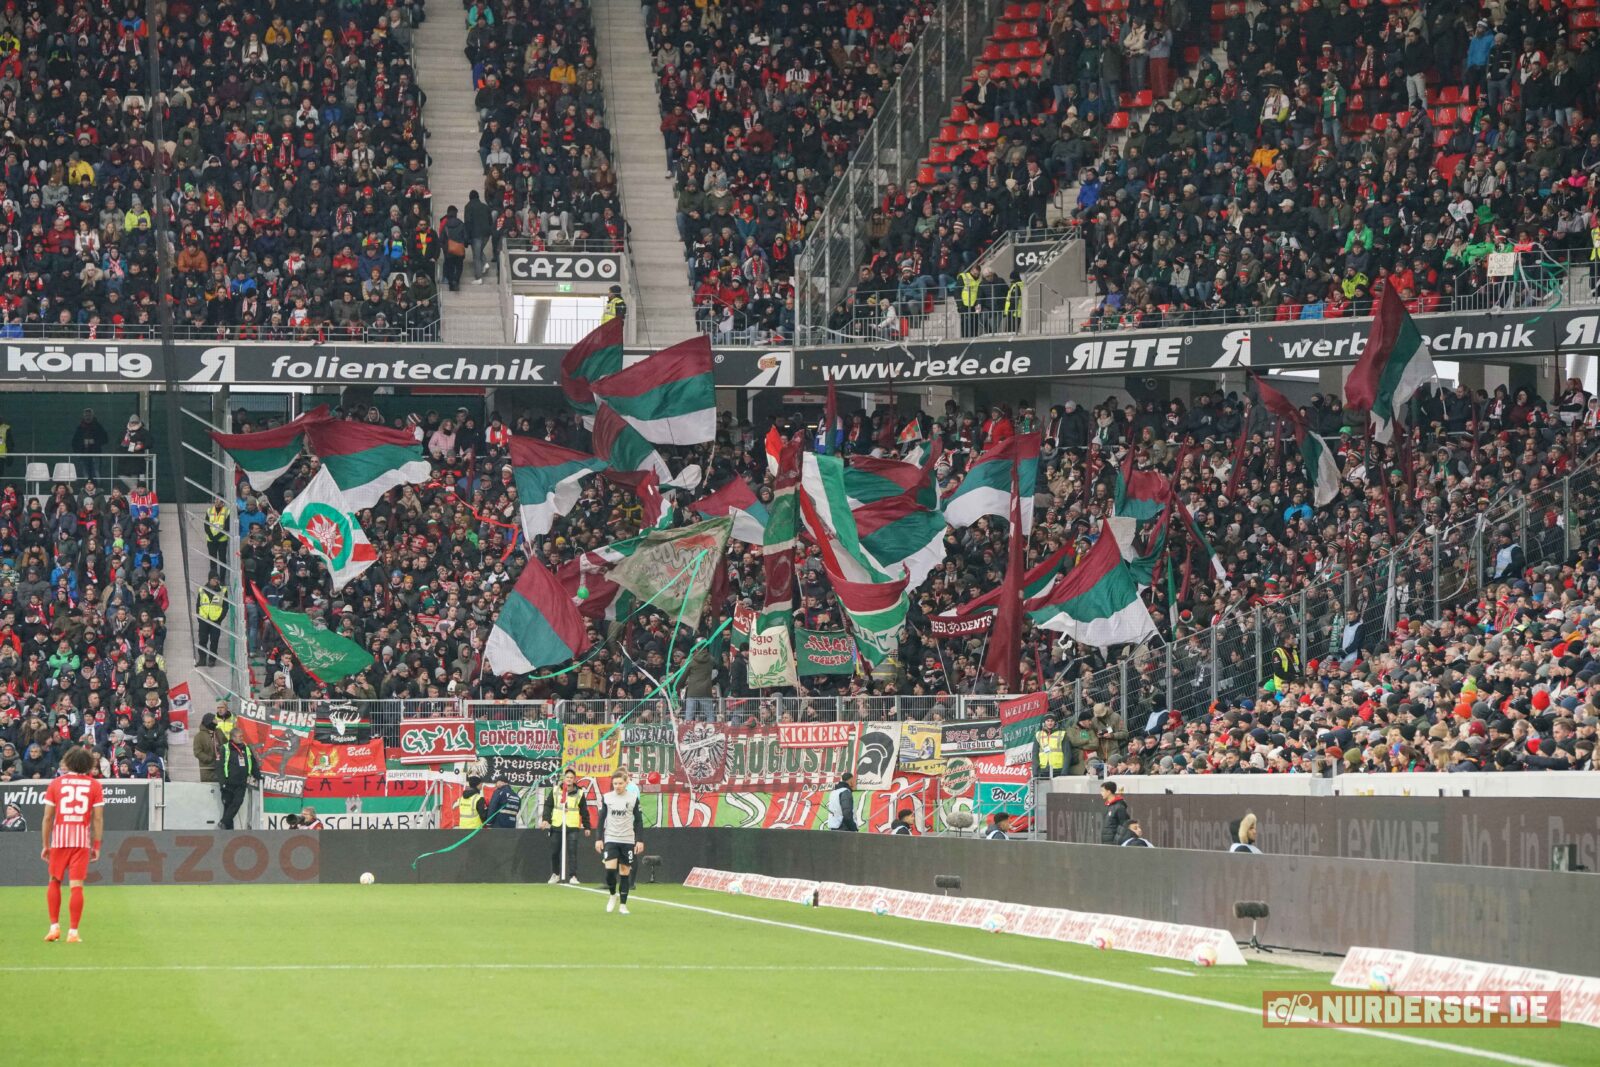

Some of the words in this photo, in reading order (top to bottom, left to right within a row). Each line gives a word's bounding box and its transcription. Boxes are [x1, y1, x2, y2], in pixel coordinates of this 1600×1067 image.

[512, 257, 617, 279] CAZOO
[1282, 323, 1536, 359] werbechnik
[7, 346, 152, 377] könig
[271, 355, 546, 381] folientechnik
[822, 350, 1031, 381] www.rete.de
[960, 615, 992, 632] DENTS
[240, 700, 266, 721] FCA
[278, 710, 317, 728] FANS
[479, 729, 560, 746] CONCORDIA
[567, 729, 594, 742] Frei
[624, 726, 674, 745] LUSTENAU
[780, 726, 848, 743] KICKERS
[346, 746, 371, 757] Bella
[338, 764, 377, 775] Augusta
[264, 776, 304, 795] RECHTS
[992, 787, 1022, 802] Bros.
[60, 786, 90, 814] 25
